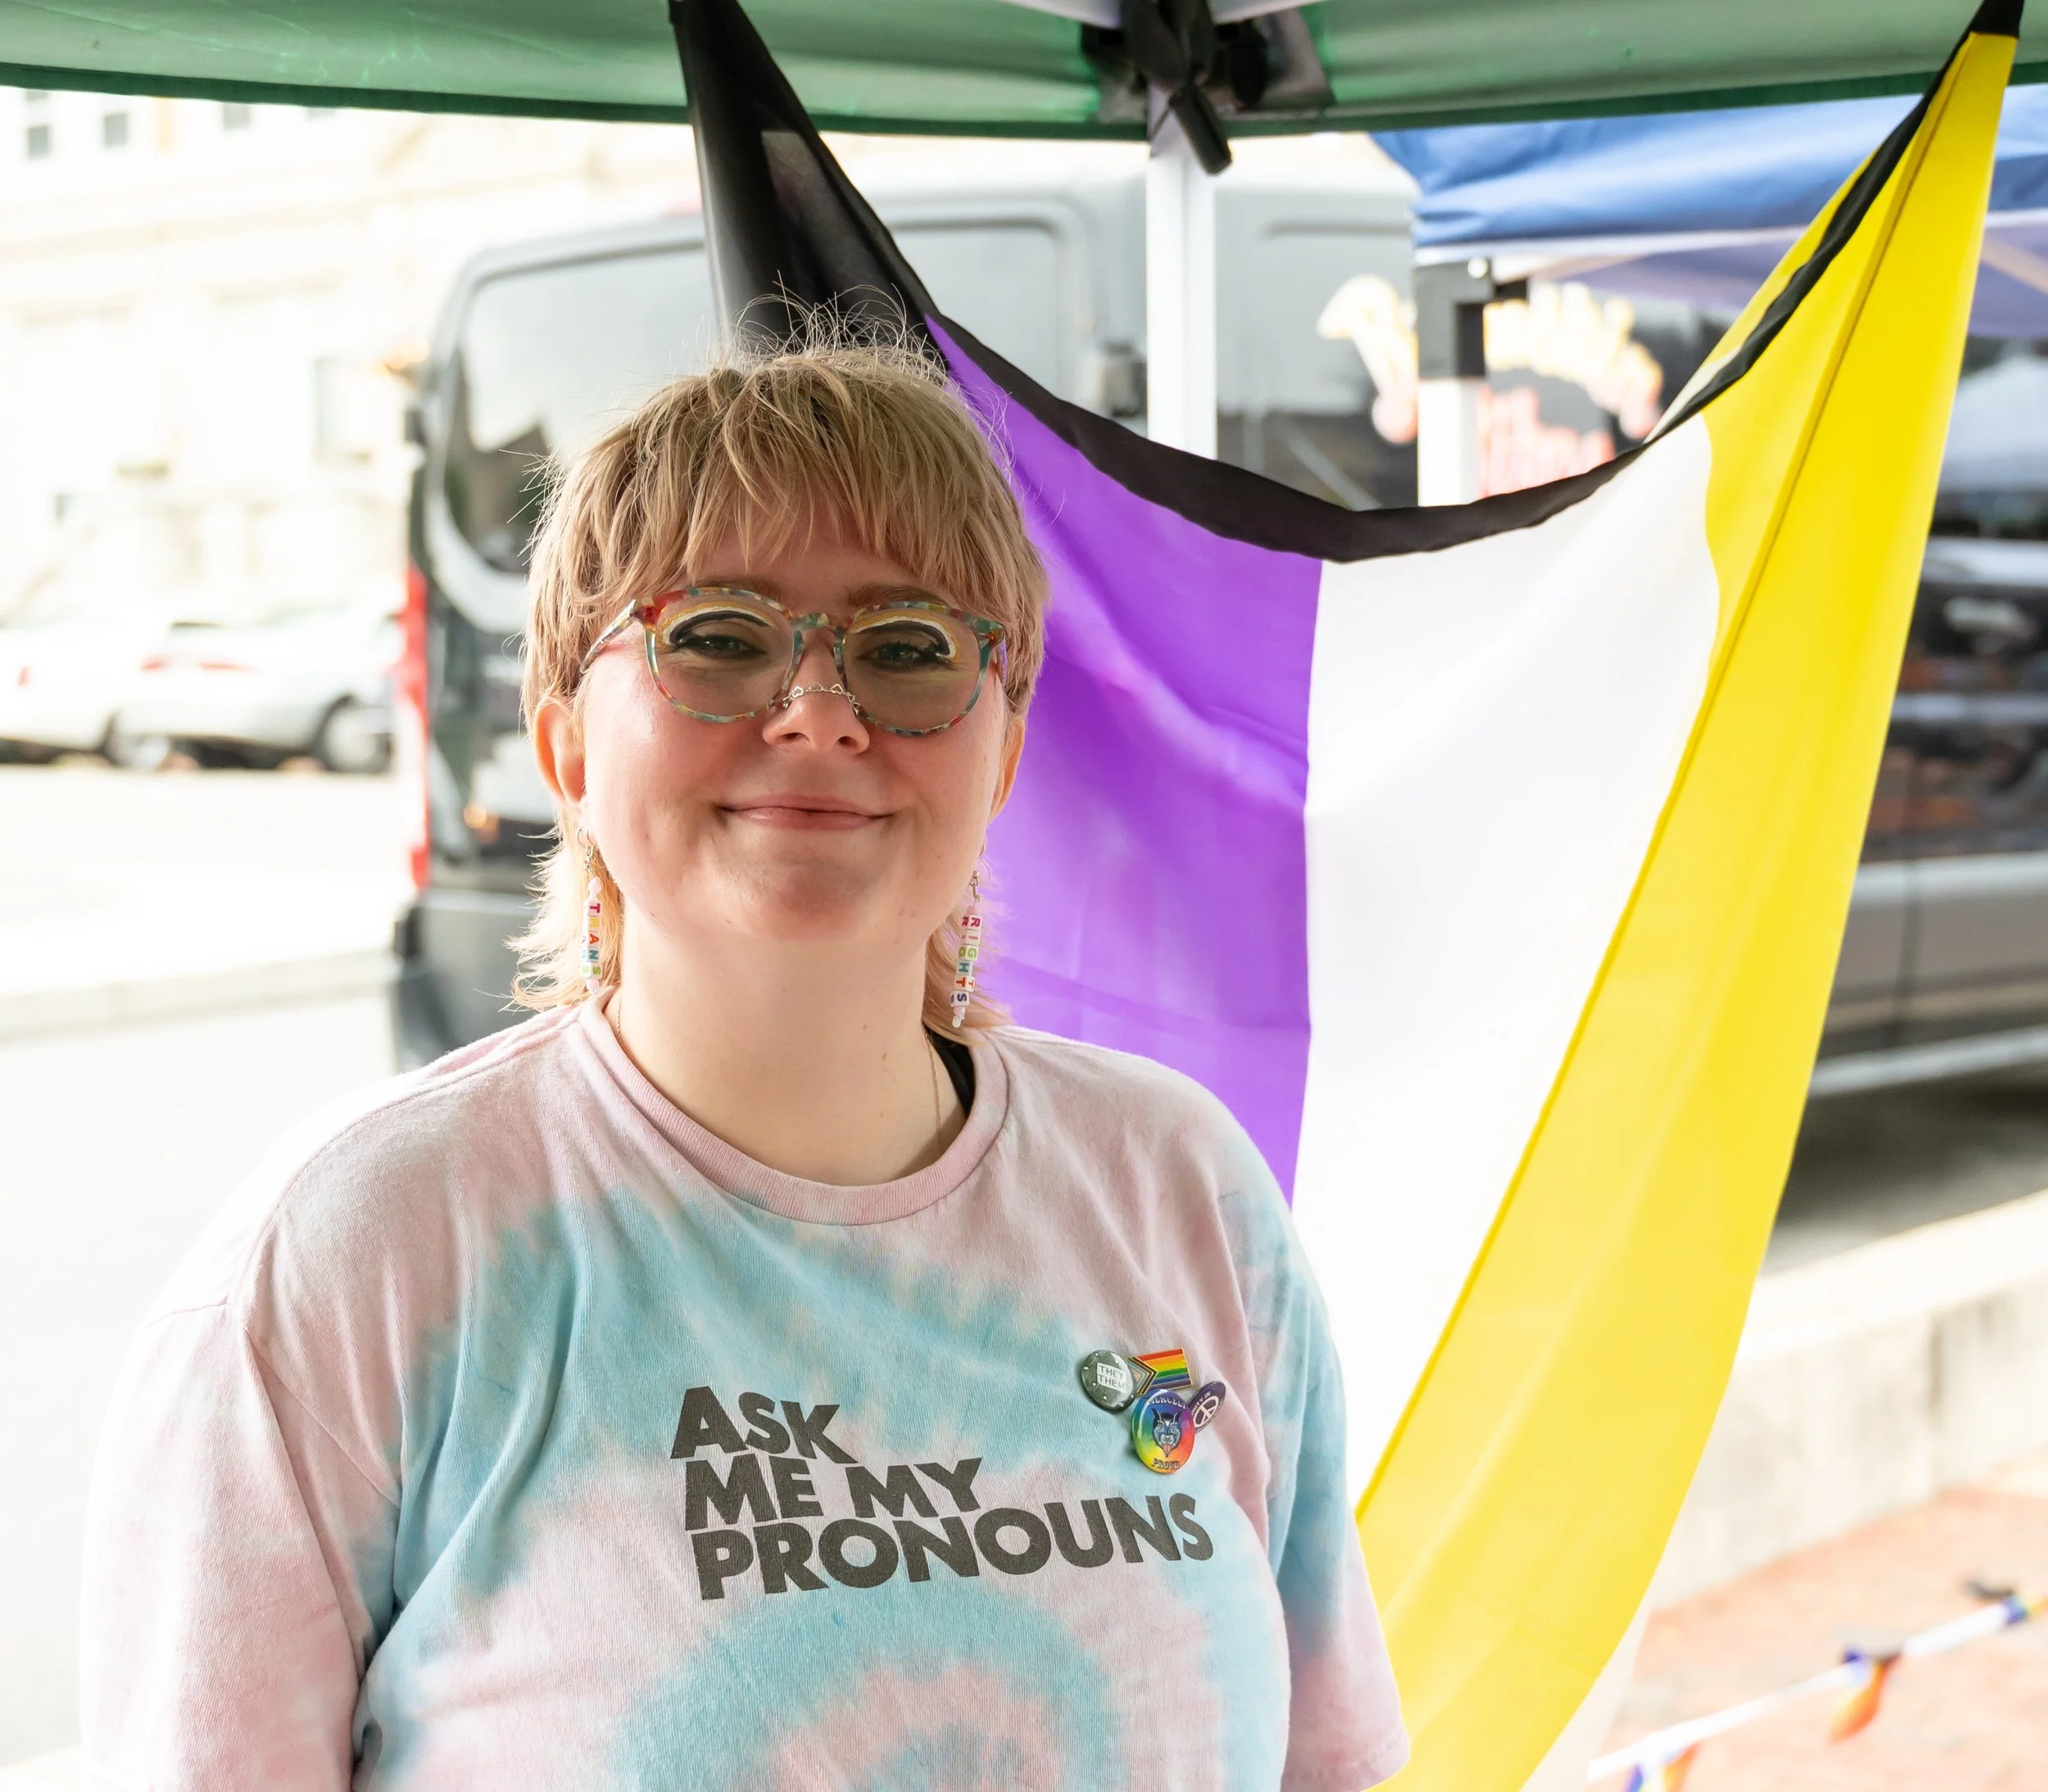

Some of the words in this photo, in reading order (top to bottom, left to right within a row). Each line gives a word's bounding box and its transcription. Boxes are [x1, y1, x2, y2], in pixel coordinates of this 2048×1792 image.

[589, 903, 601, 975] TRANS
[956, 916, 981, 1002] RIGHTS
[1098, 1374, 1128, 1390] THEM
[1099, 1364, 1123, 1379] THEY
[670, 1386, 859, 1464] ASK
[685, 1454, 822, 1531] ME
[846, 1457, 982, 1518] MY
[1151, 1458, 1180, 1470] PROUD
[691, 1492, 1214, 1600] PRONOUNS
